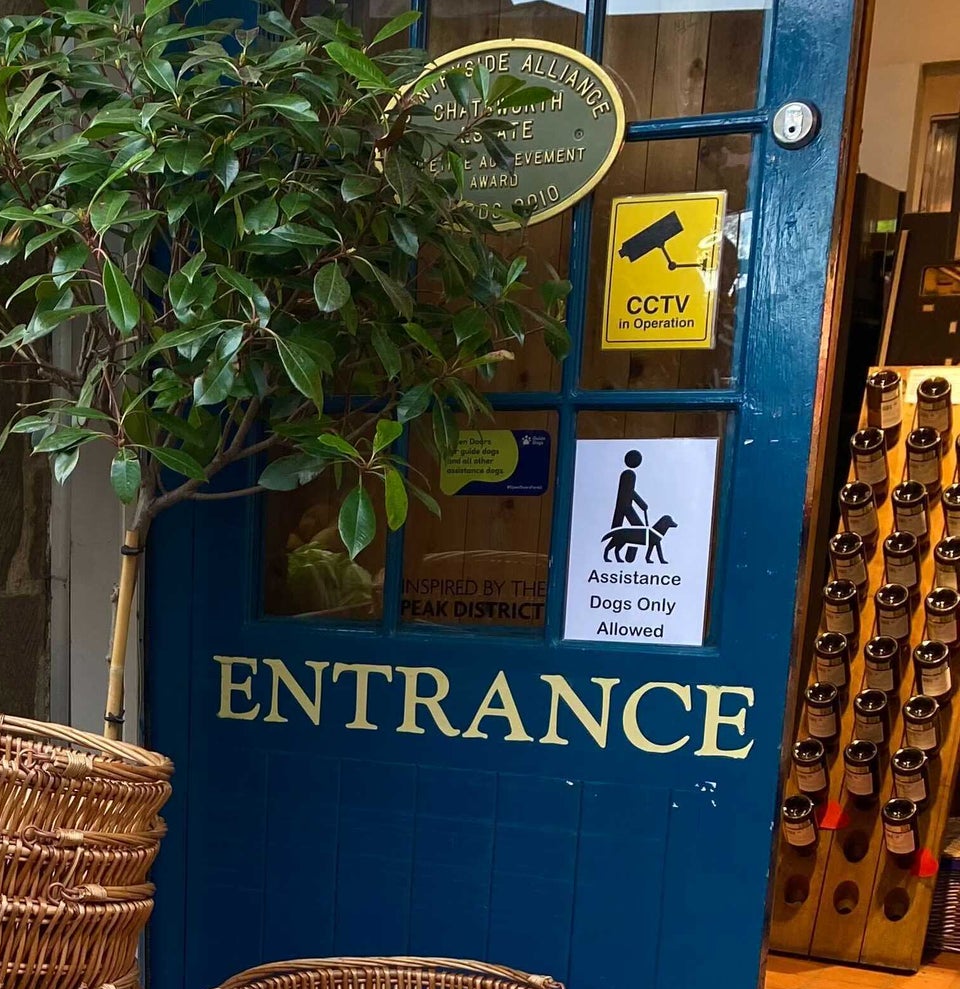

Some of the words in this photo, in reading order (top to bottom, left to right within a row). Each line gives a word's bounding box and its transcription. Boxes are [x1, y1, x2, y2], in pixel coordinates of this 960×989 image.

[521, 53, 611, 119] ALLIANCE
[470, 173, 519, 189] AWARD
[626, 294, 690, 315] CCTV
[618, 318, 630, 329] in
[633, 317, 695, 332] Operation
[460, 447, 481, 457] guide
[482, 447, 500, 457] dogs
[587, 569, 682, 586] Assistance
[401, 578, 478, 596] INSPIRED
[483, 579, 506, 596] BY
[511, 580, 546, 597] THE
[400, 599, 449, 617] PEAK
[453, 600, 545, 619] DISTRICT
[590, 595, 632, 613] Dogs
[637, 597, 676, 616] Only
[596, 621, 664, 638] Allowed
[212, 654, 755, 760] ENTRANCE
